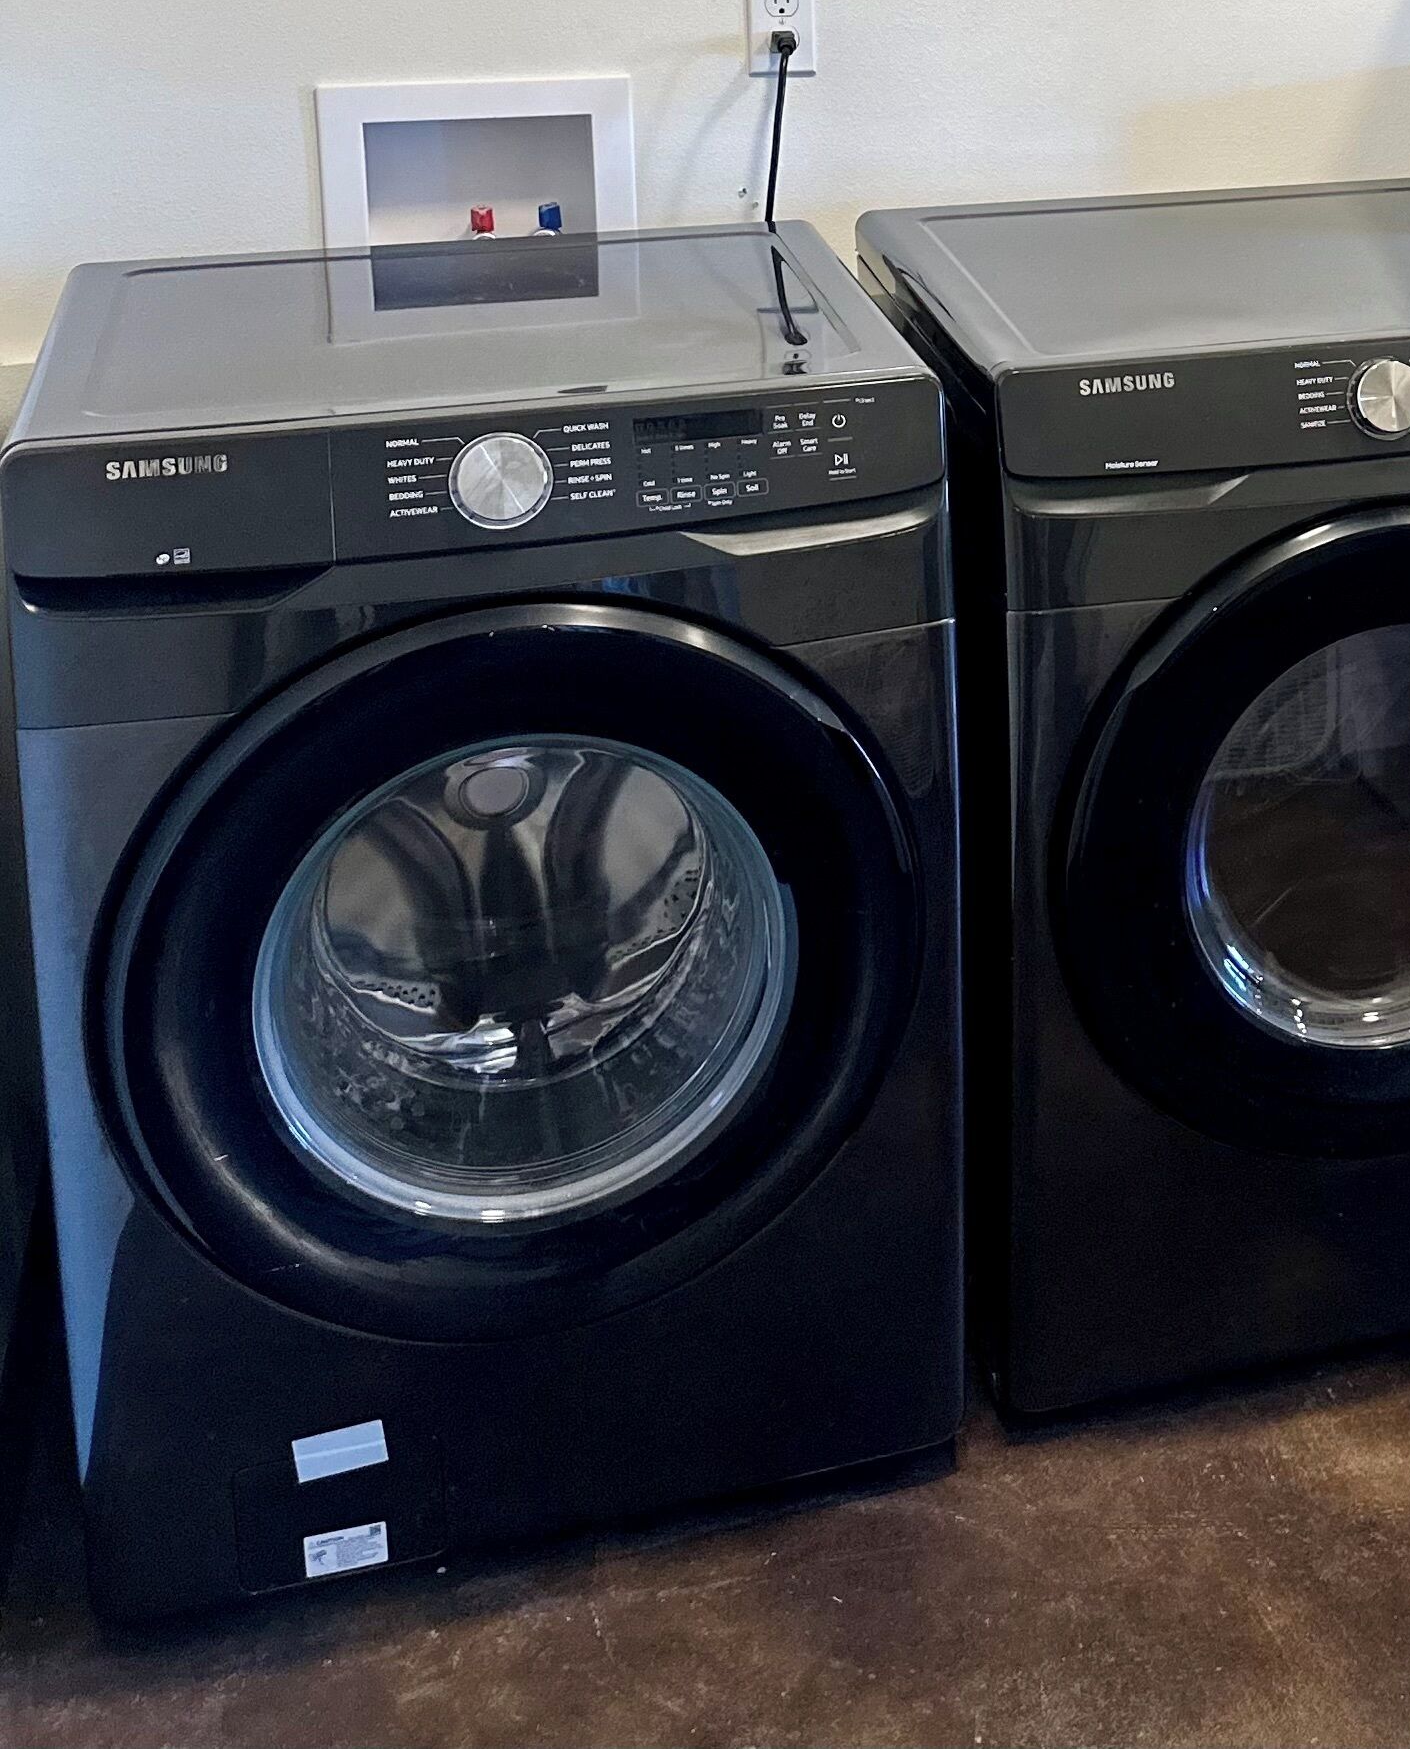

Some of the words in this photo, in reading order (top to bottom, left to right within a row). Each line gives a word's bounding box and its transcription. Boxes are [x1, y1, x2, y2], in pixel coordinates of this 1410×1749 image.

[1080, 372, 1175, 396] SAMSUNG
[1296, 378, 1316, 386] HEAVY
[1317, 376, 1333, 384] DUTY
[1300, 404, 1337, 414] ACTIVEWEAR
[798, 412, 816, 420] Delay
[563, 424, 587, 433] QUICK
[587, 422, 609, 431] WASH
[802, 419, 814, 427] End
[385, 438, 420, 448] NORMAL
[571, 441, 611, 451] DELICATES
[772, 440, 792, 448] Alarm
[800, 437, 818, 445] Smart
[777, 447, 788, 455] Off
[386, 459, 413, 468] HEAVY
[413, 456, 435, 466] DUTY
[570, 459, 590, 468] PERM
[590, 457, 611, 466] PRESS
[1105, 461, 1134, 470] Moisture
[1134, 460, 1159, 468] Sensor
[105, 454, 228, 481] SAMSUNG
[387, 474, 417, 484] WHITES
[568, 476, 590, 484] RINSE
[595, 473, 612, 481] SPIN
[711, 487, 728, 496] Spin
[746, 483, 759, 492] Soil
[389, 490, 424, 501] BEDDING
[570, 491, 588, 501] SELF
[677, 491, 696, 499] Rinse
[389, 505, 438, 518] ACTIVEWEAR
